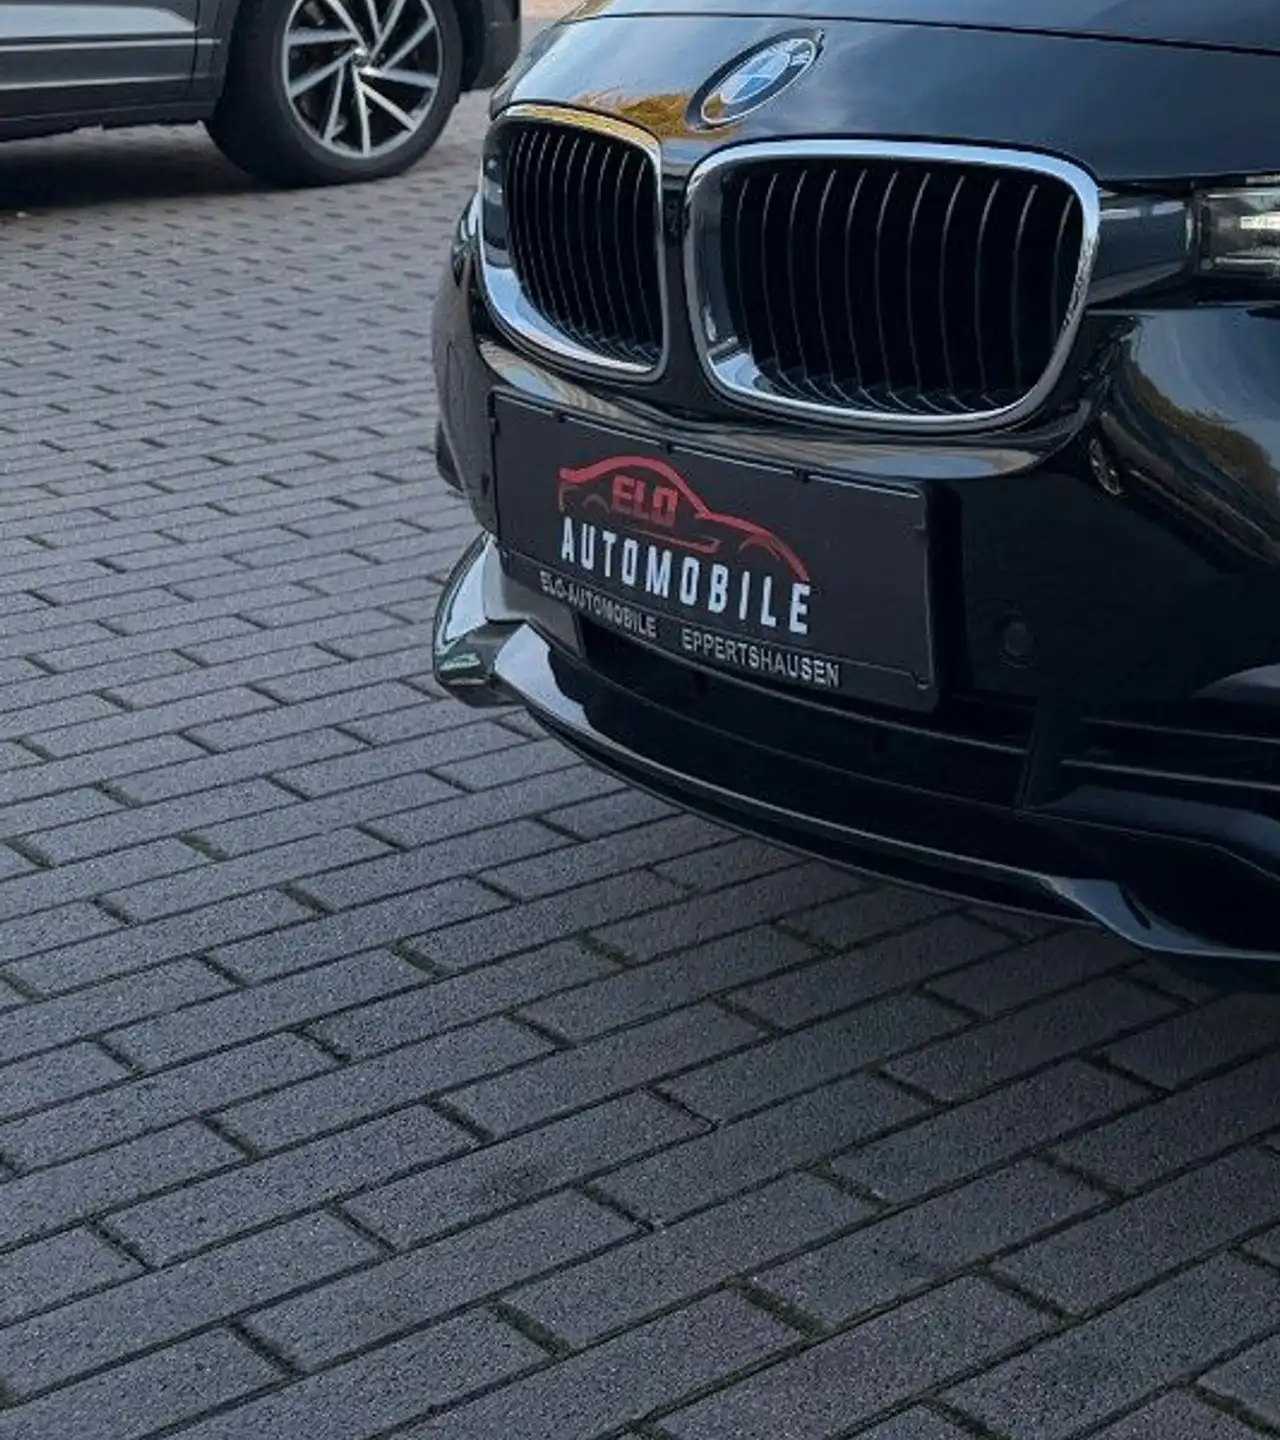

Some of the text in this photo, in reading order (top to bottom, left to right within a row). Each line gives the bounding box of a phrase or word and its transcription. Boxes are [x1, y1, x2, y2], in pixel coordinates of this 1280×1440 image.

[611, 474, 679, 528] ELO
[560, 515, 811, 636] AUTOMOBILE
[681, 627, 840, 688] EPPERTSHAUSEN
